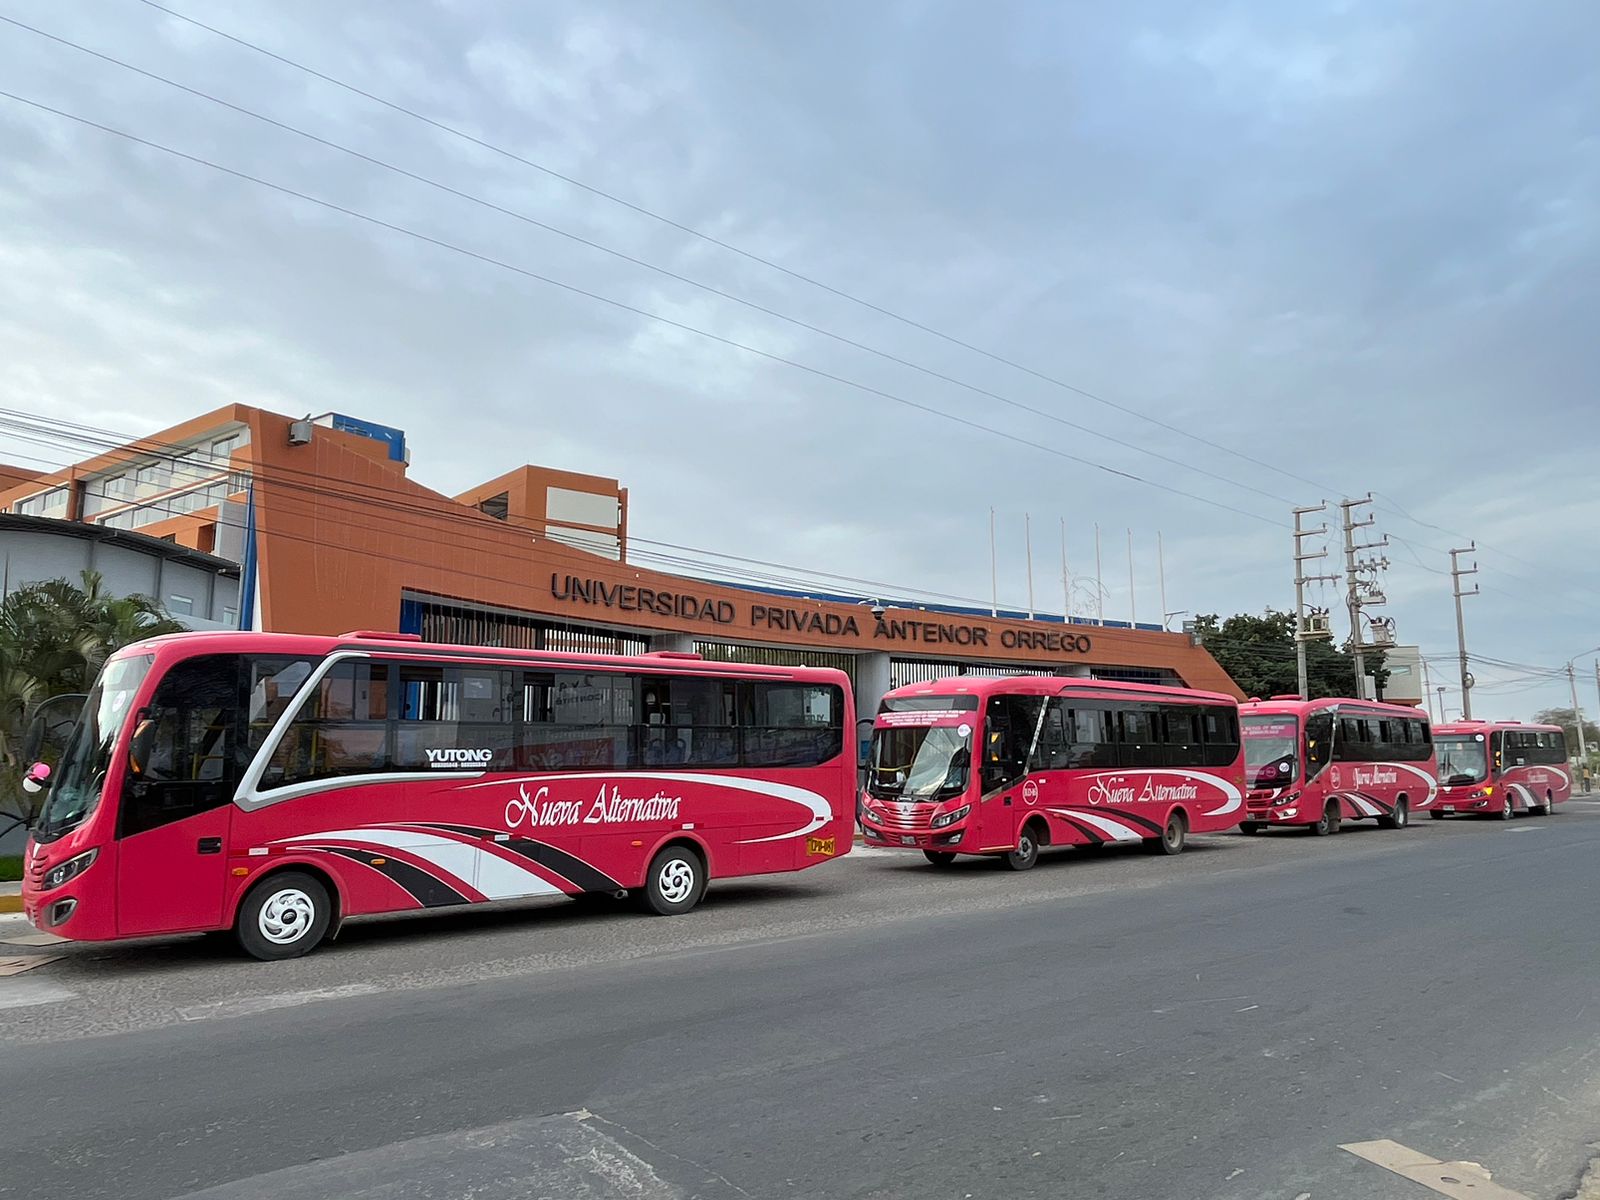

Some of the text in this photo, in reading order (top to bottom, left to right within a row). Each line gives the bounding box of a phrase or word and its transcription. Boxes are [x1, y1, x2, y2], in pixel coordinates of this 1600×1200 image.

[551, 572, 1092, 653] UNIVERSIDAD PRIVADA ANTENOR ORREGO
[425, 748, 493, 762] YUTONG
[504, 784, 681, 829] Nueva Alternativa
[1088, 774, 1198, 805] Nueva Alternativa
